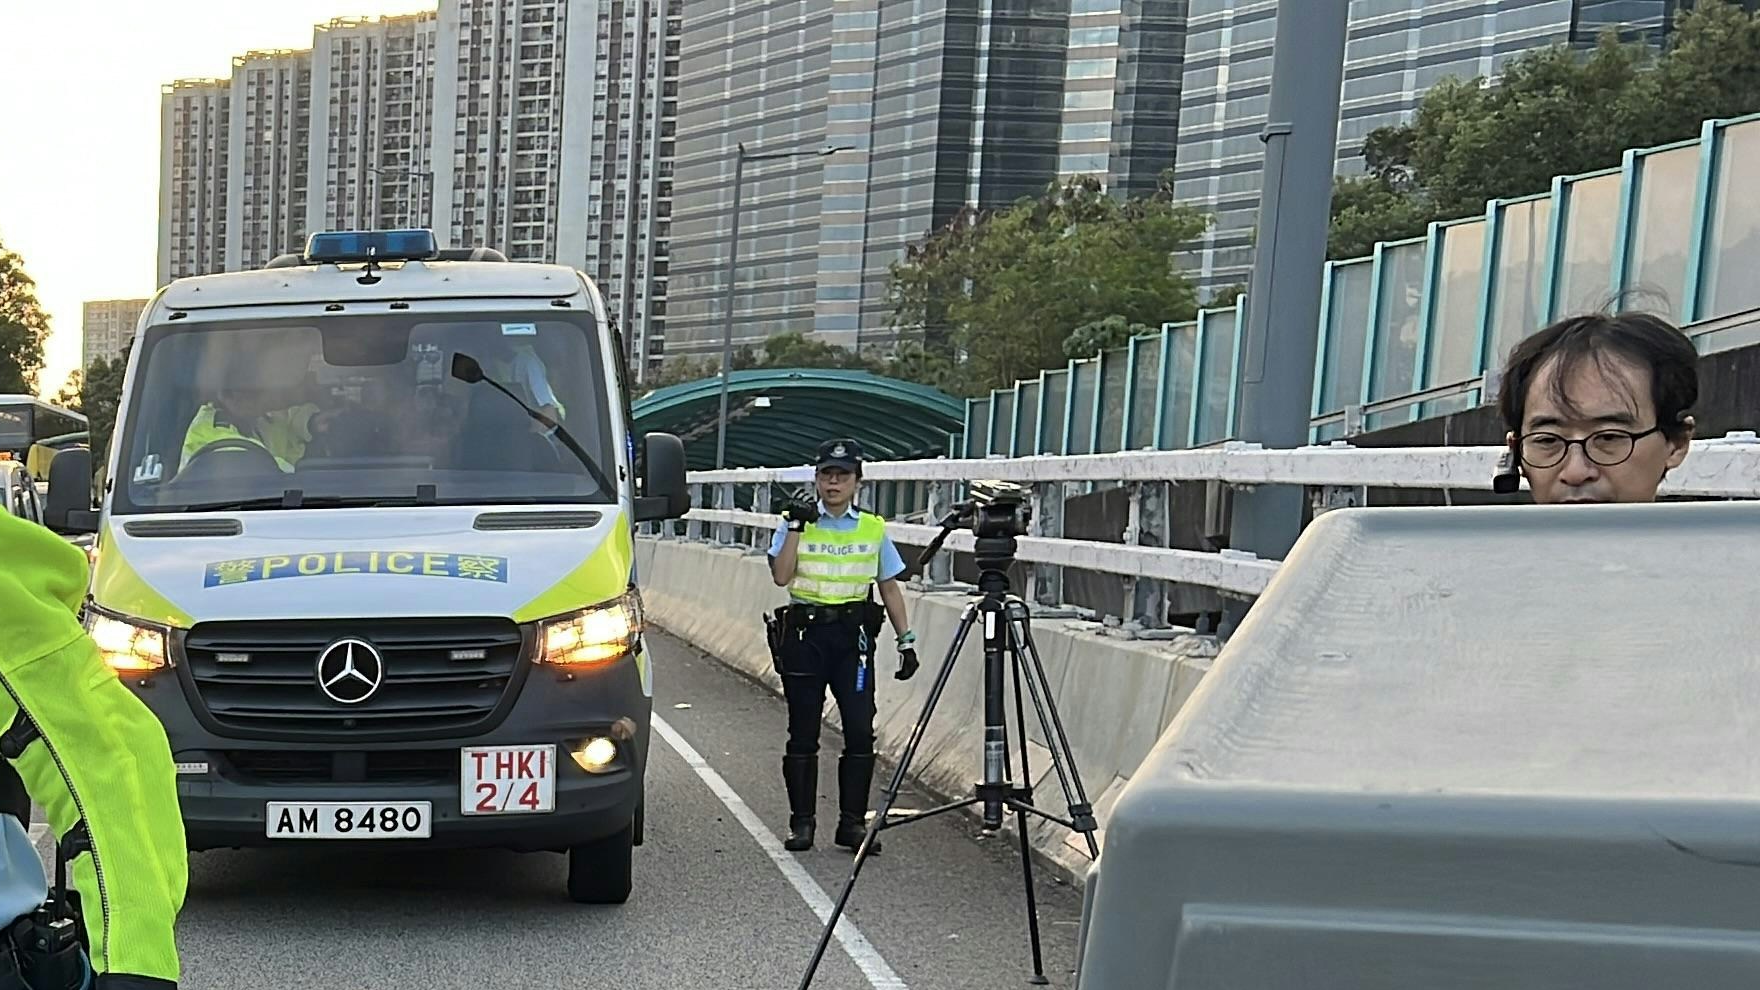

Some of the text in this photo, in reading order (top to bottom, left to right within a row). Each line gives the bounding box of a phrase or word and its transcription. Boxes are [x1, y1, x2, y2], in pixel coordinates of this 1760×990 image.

[820, 544, 854, 556] POLICE
[213, 551, 500, 585] 警 POLICE 察
[475, 781, 540, 812] 2/4
[276, 806, 422, 833] AM 8480
